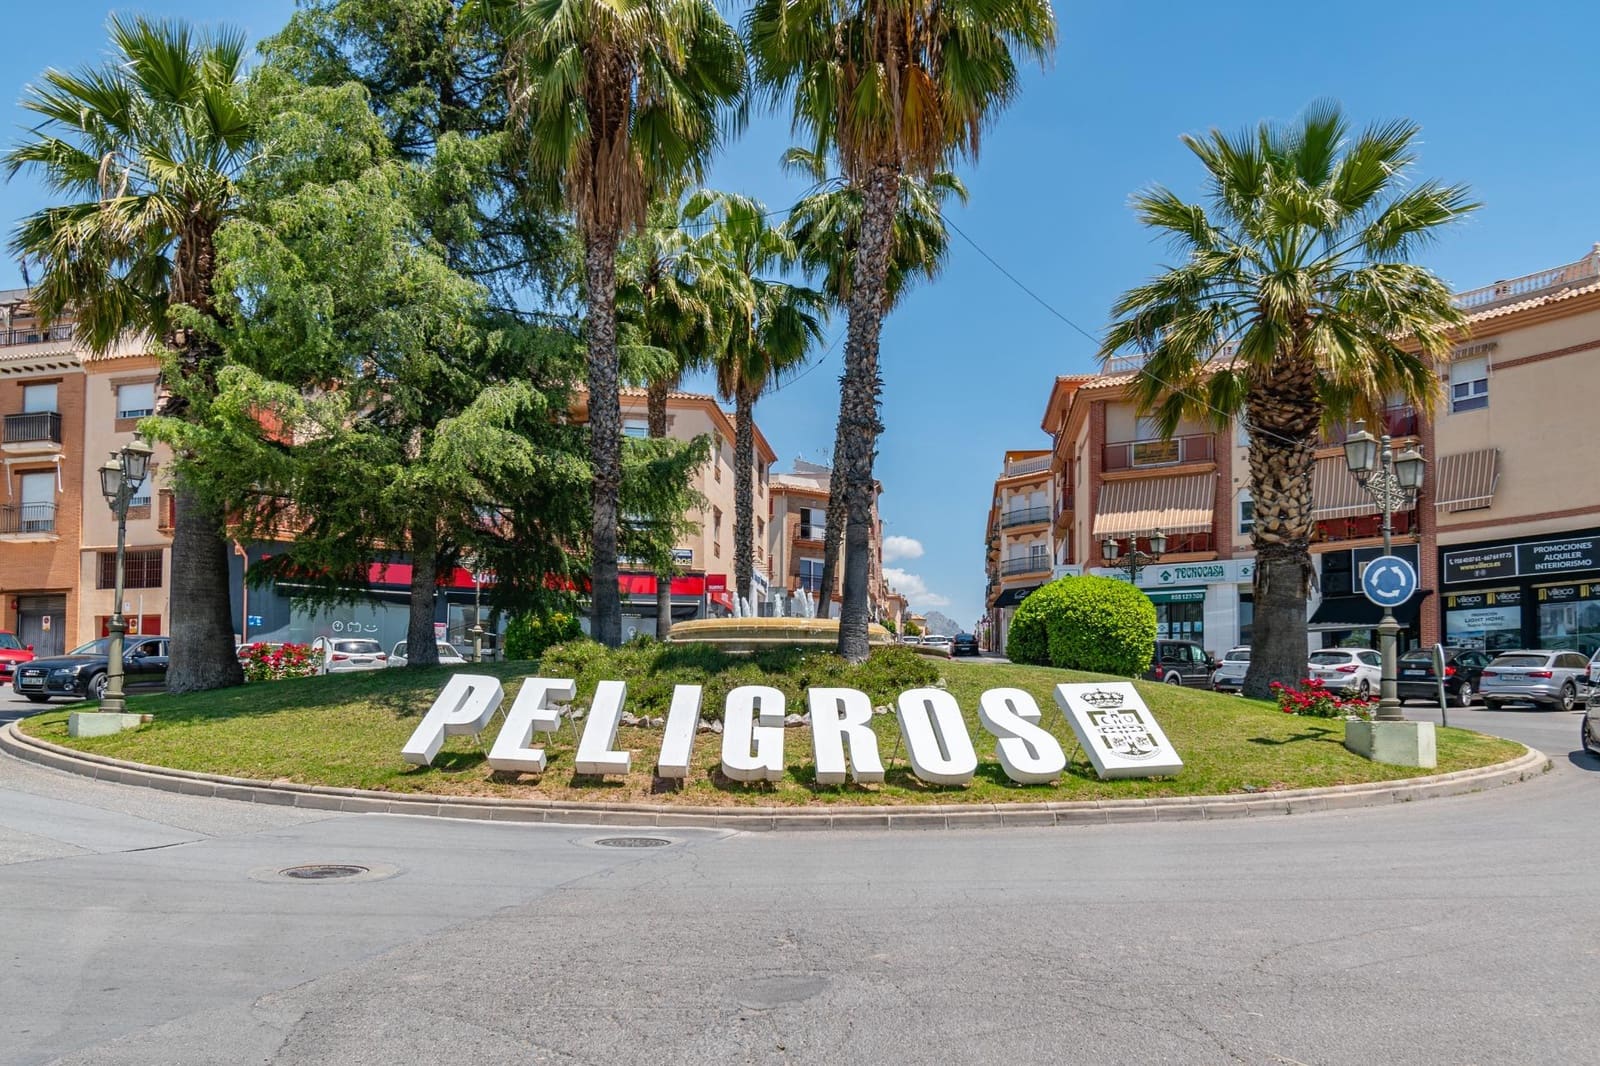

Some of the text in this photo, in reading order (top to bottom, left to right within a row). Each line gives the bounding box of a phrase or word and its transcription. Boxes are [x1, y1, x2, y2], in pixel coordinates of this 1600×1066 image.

[1533, 542, 1593, 554] PROMOCIONES
[1543, 551, 1582, 561] ALQUILER
[1535, 559, 1592, 570] INTERIORISMO
[1175, 565, 1224, 579] TECNOCASA
[401, 673, 1067, 785] PELIGROS
